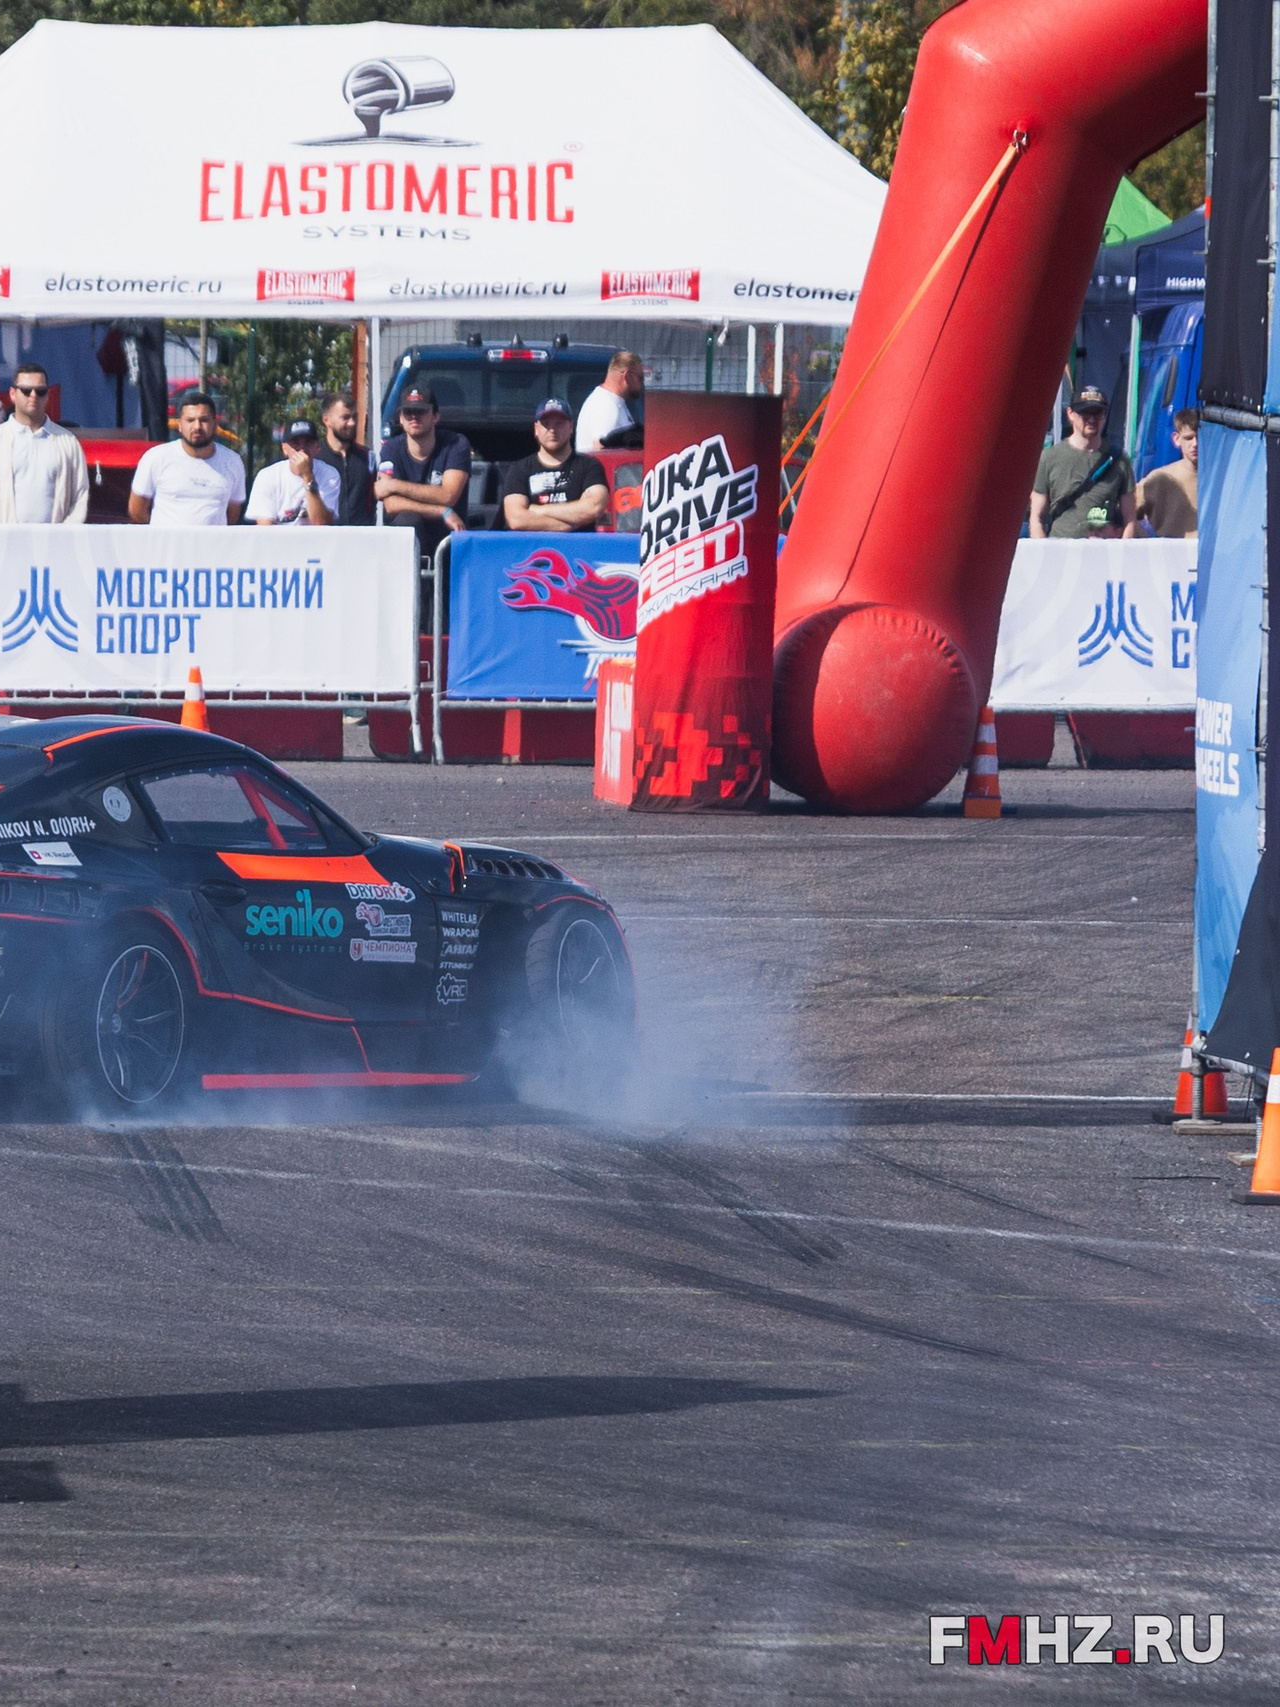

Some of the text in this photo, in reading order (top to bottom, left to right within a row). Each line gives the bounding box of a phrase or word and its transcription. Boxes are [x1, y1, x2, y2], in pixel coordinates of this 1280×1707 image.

[199, 159, 574, 224] ELASTOMERIC
[302, 224, 471, 241] SYSTEMS
[45, 272, 222, 294] elastomeric.ru
[264, 269, 348, 298] ELASTOMERIC
[389, 277, 567, 298] elastomeric.ru
[609, 269, 692, 296] ELASTOMERIC
[96, 558, 323, 609] МОСКОВСКИЙ
[96, 612, 201, 654] СПОРТ
[33, 819, 50, 836] N.
[347, 883, 399, 900] DRYDRY
[246, 889, 344, 938] seniko
[441, 910, 477, 924] WHITELAB
[242, 941, 344, 954] Brake systems
[365, 942, 415, 953] ЧЕМПИОНАТ
